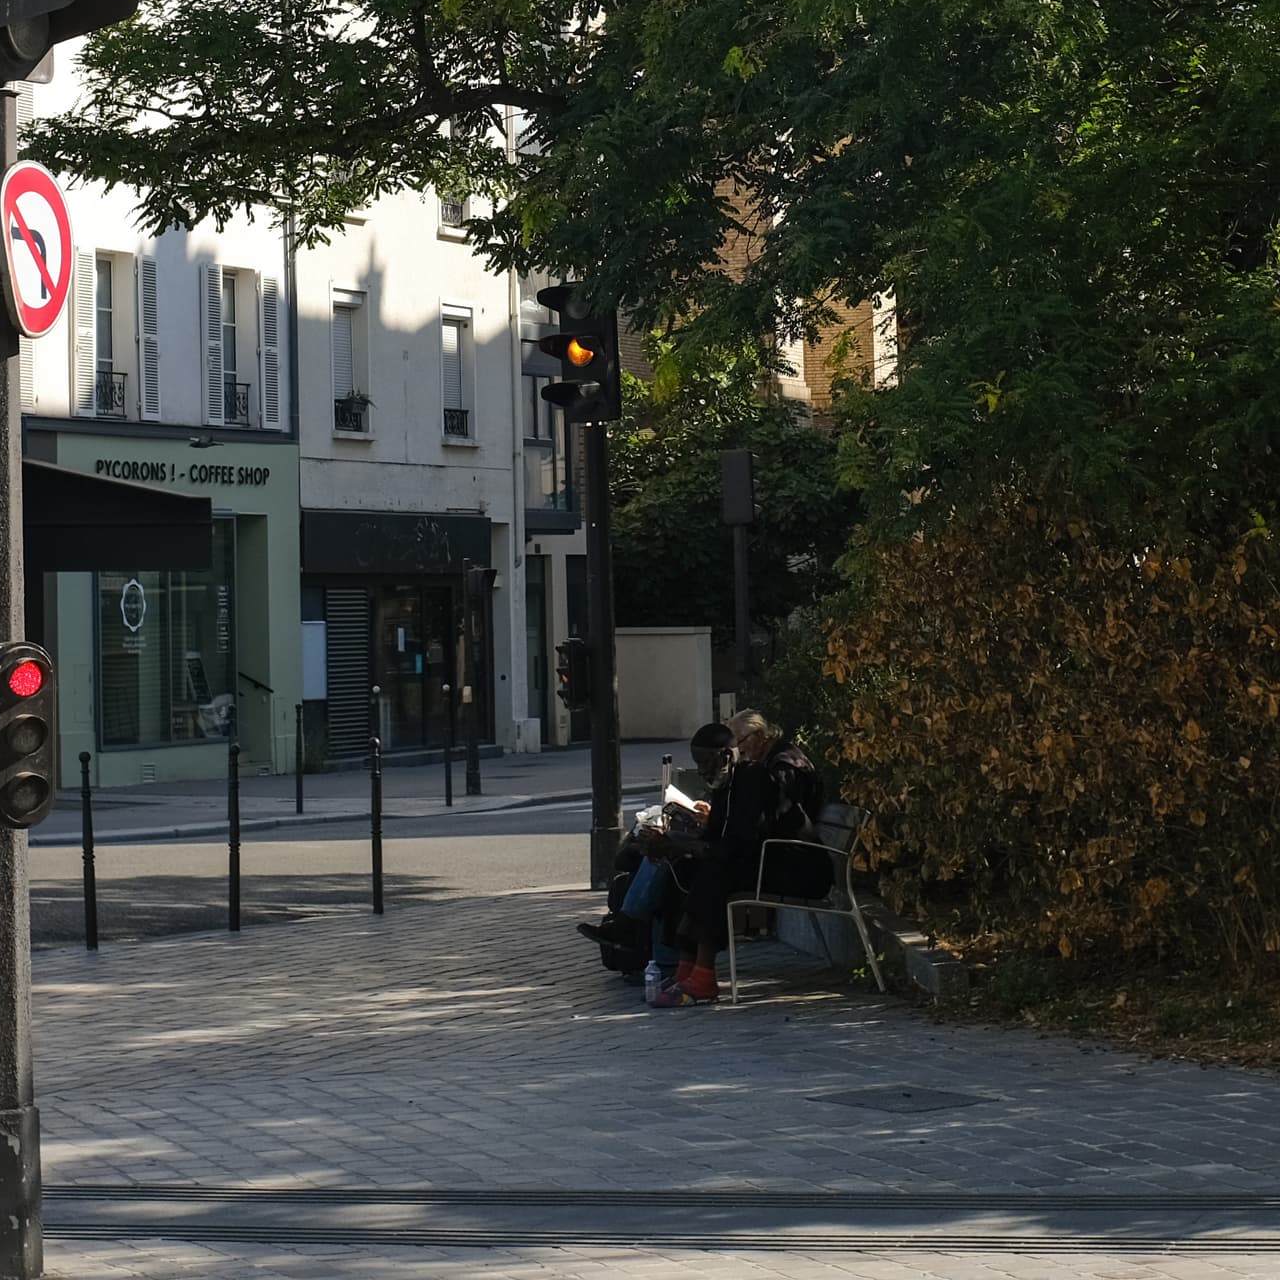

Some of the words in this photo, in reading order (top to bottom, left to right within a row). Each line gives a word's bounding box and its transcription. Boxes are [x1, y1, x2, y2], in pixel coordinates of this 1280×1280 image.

[95, 459, 166, 482] PYCORONS
[170, 463, 176, 482] !
[189, 464, 235, 484] COFFEE
[237, 466, 271, 486] SHOP
